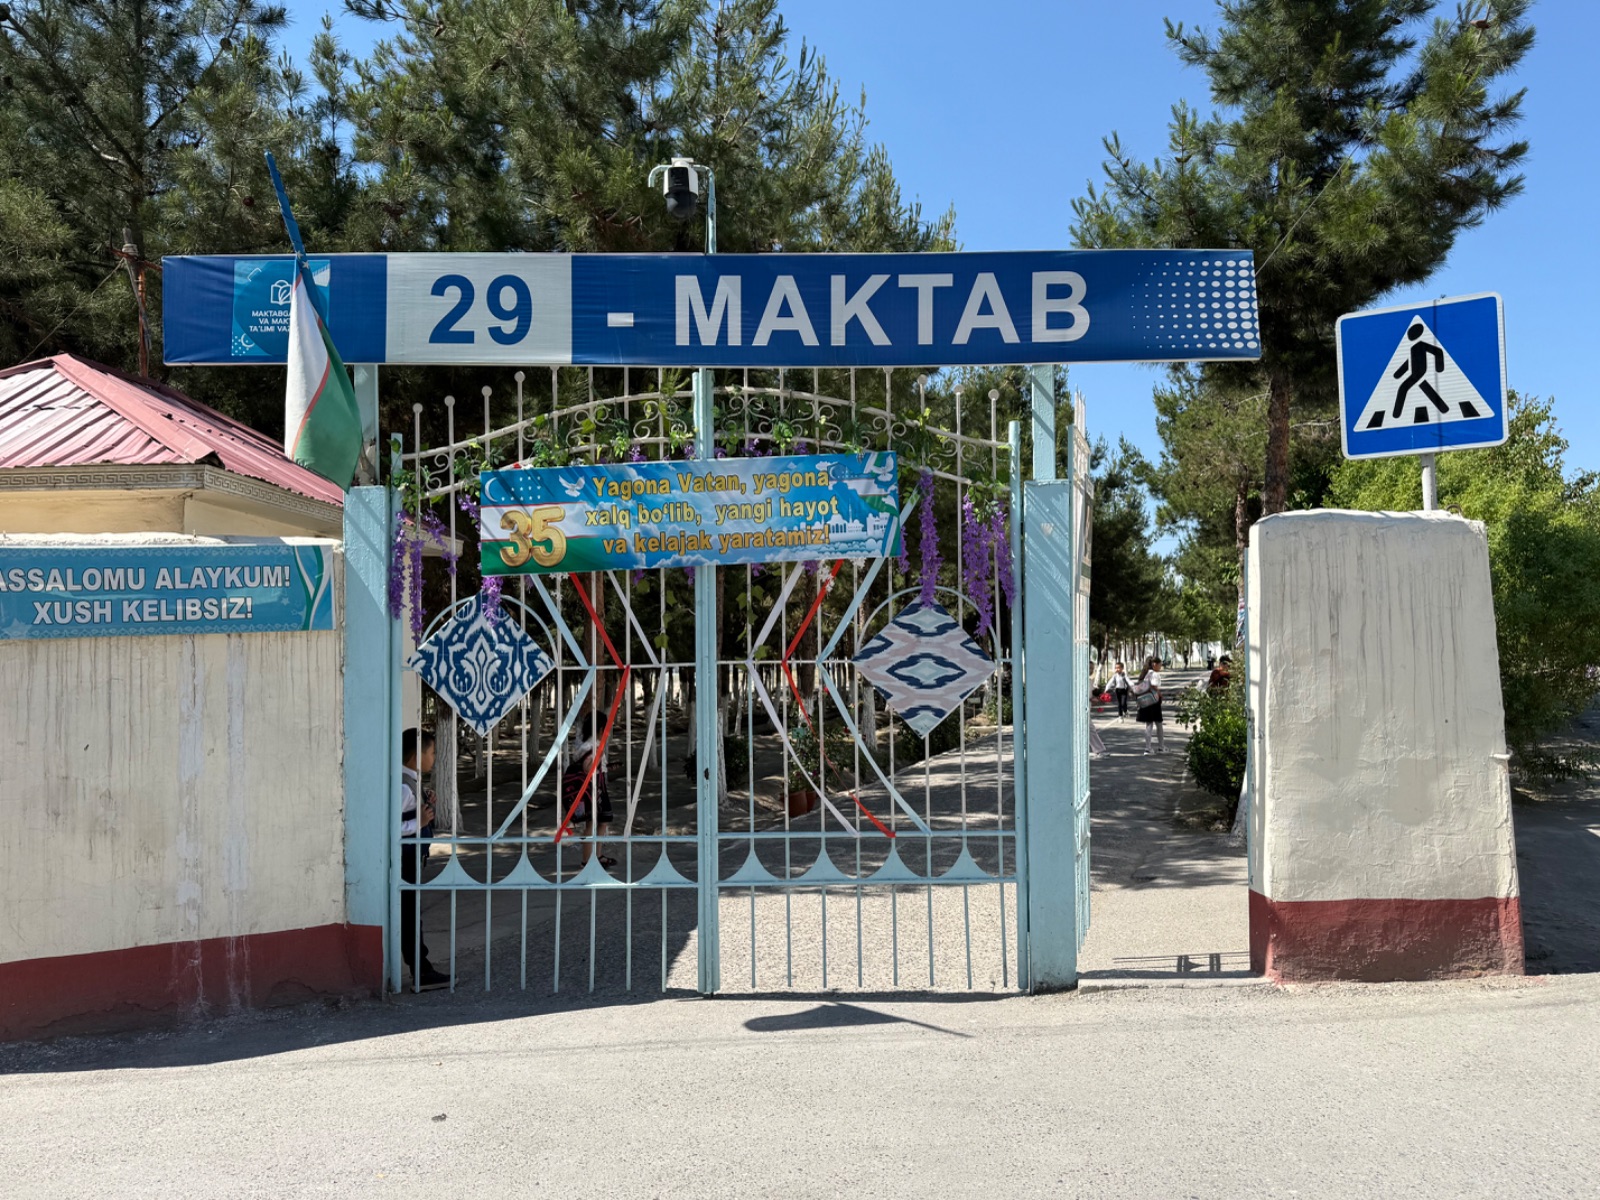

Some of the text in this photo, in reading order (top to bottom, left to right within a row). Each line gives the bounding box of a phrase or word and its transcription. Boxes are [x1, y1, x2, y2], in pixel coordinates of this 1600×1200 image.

[258, 317, 269, 325] VA
[429, 271, 1091, 347] 29 - MAKTAB
[592, 469, 830, 500] Yagona Vatan, yagona
[585, 505, 631, 530] xalq
[715, 498, 773, 524] yangi
[780, 495, 839, 521] hayot
[500, 506, 566, 567] 35
[603, 525, 831, 555] va kelajak yaratamiz!
[155, 566, 290, 590] ALAYKUM!
[33, 597, 253, 625] XUSH KELIBSIZ!
